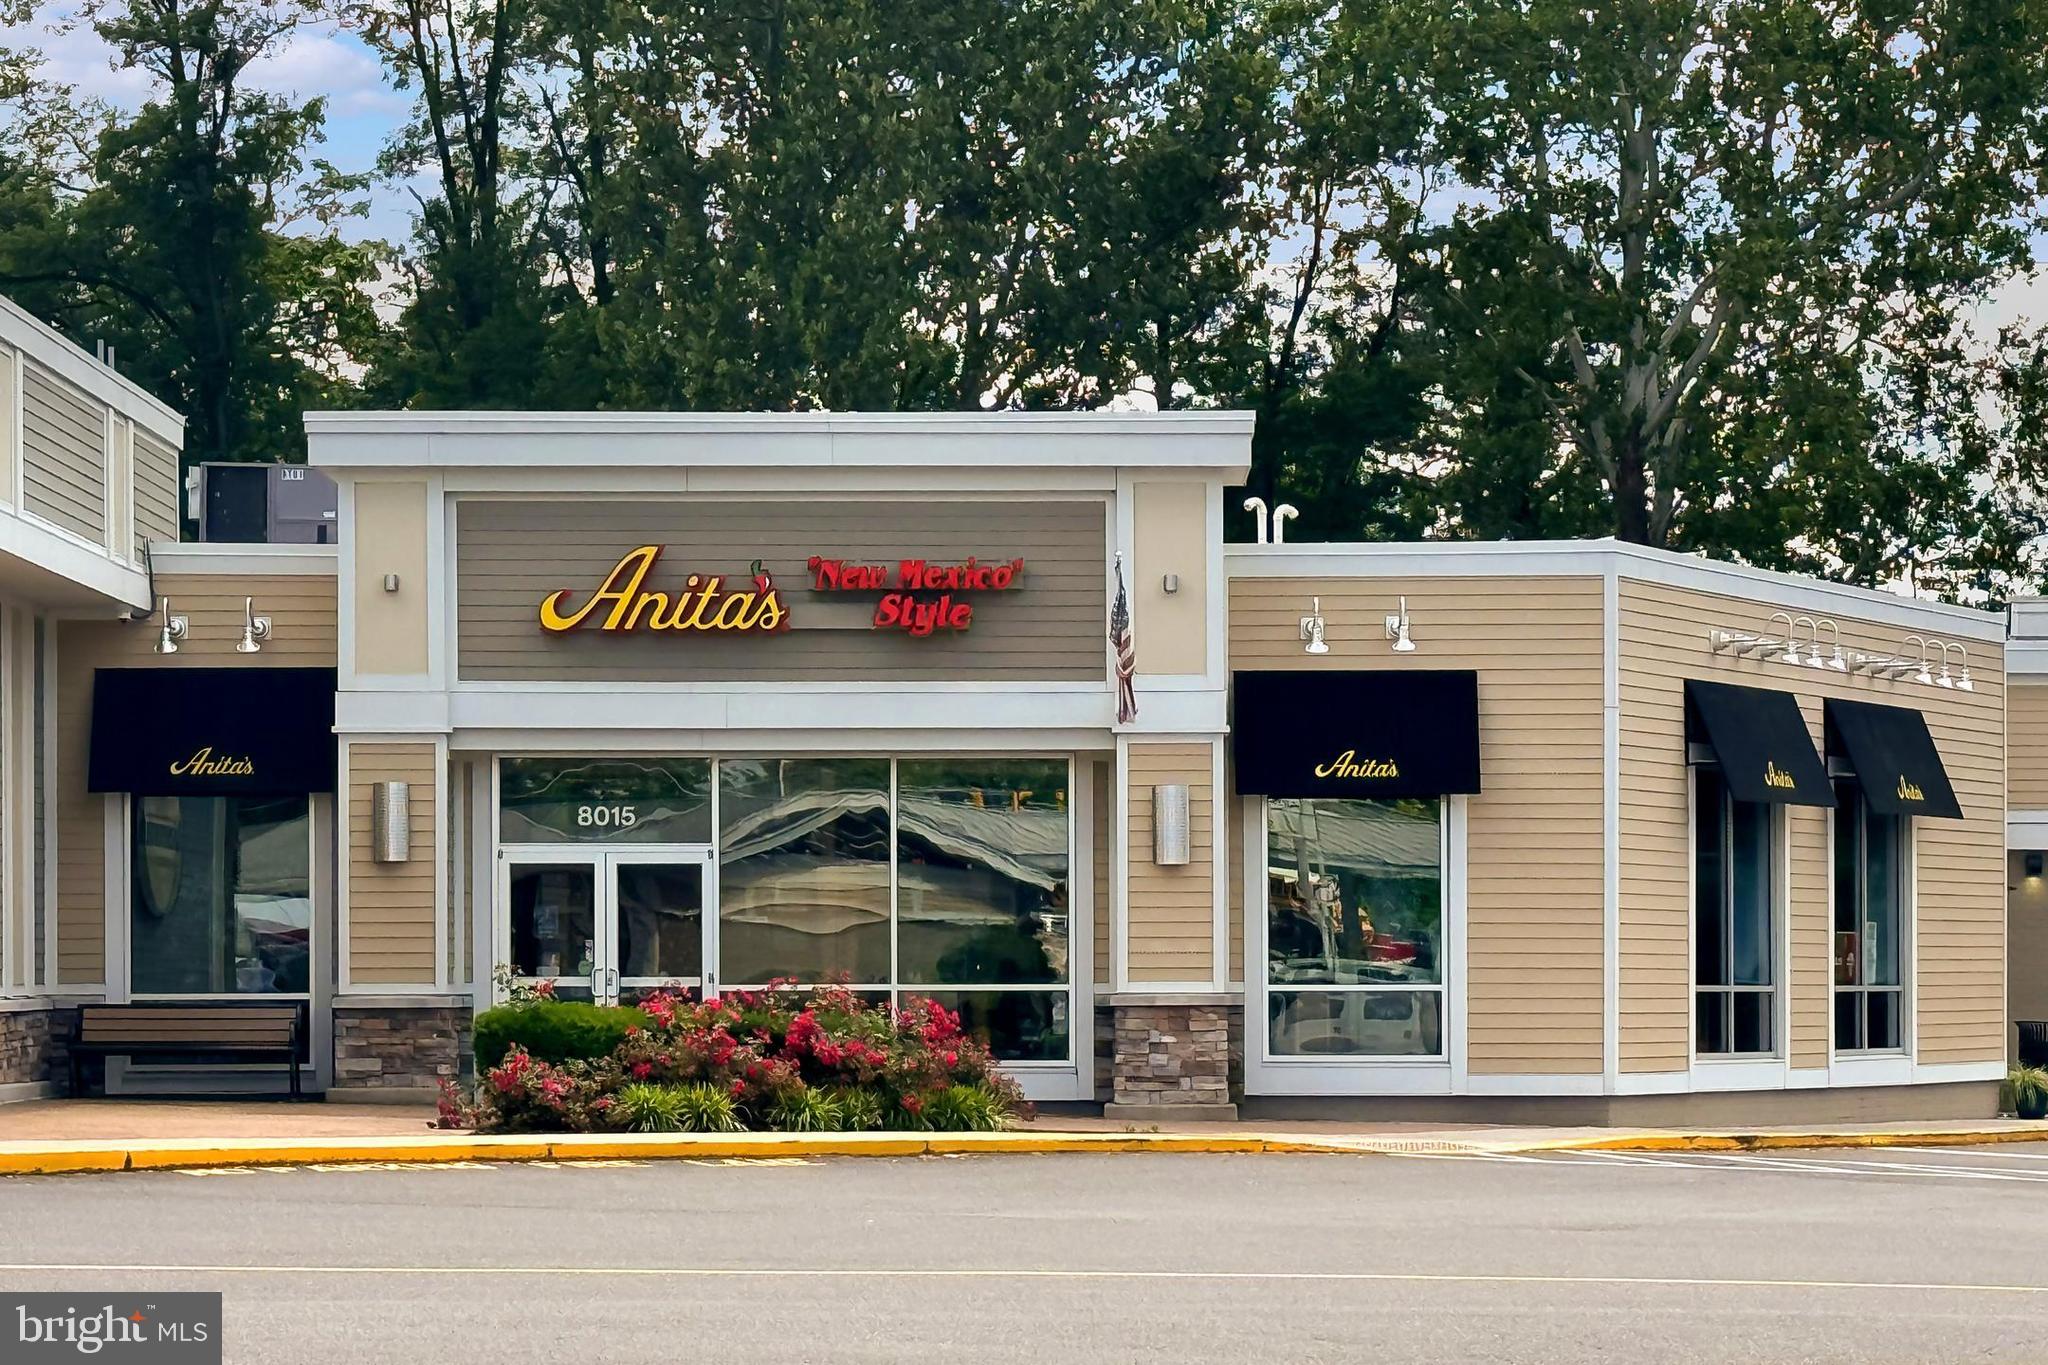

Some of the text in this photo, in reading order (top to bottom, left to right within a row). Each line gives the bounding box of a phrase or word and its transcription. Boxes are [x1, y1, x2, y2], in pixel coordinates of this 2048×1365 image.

[539, 545, 787, 631] Anita's
[874, 593, 972, 636] Style
[170, 746, 255, 775] Anita's
[1314, 749, 1399, 778] Anita's
[577, 806, 636, 826] 8015
